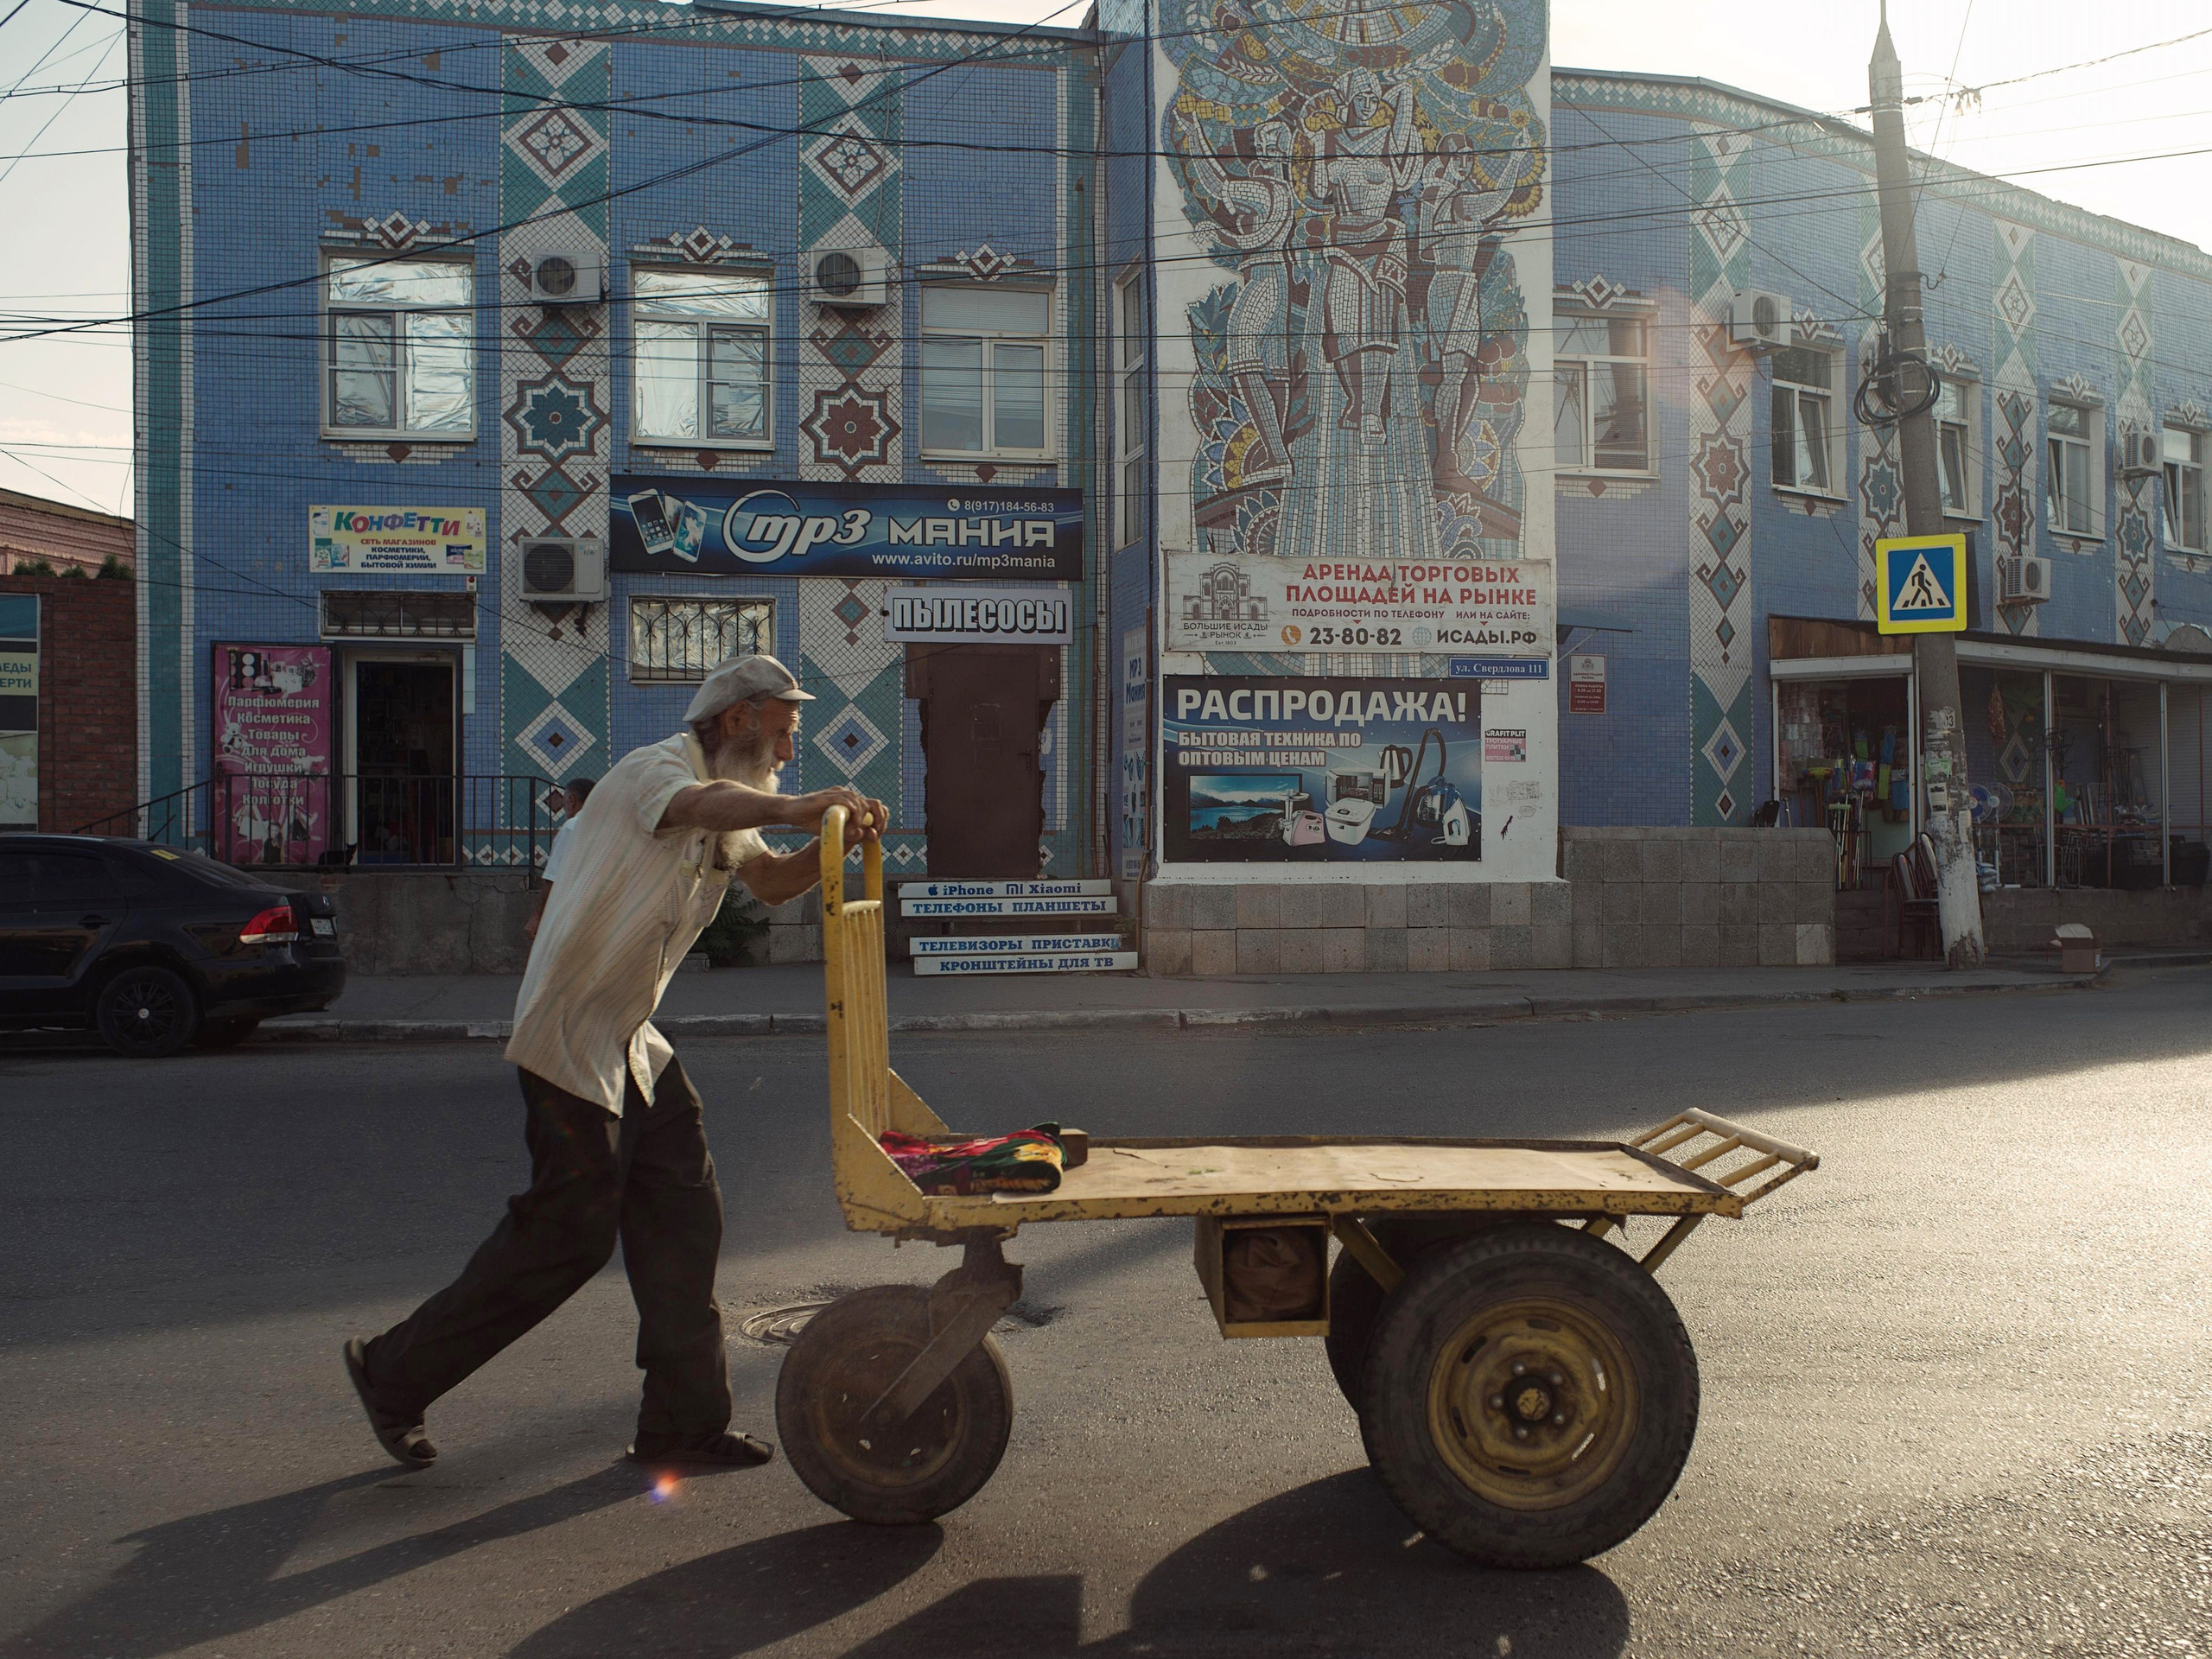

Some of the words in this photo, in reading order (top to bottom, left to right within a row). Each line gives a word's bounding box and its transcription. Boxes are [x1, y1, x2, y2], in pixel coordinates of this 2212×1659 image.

[964, 500, 1055, 512] 8(917)184-56-83
[334, 511, 461, 536] КОНФЕТТИ
[722, 499, 873, 563] mp3
[872, 551, 1056, 569] www.avito.ru/mp3mania
[1302, 563, 1393, 583] АРЕНДА
[1398, 564, 1520, 583] ТОРГОВЫХ
[1286, 582, 1415, 605] ПЛОЩАДЕЙ
[1423, 588, 1453, 604] НА
[1459, 588, 1536, 606] РЫНКЕ
[893, 597, 1066, 634] ПЫЛЕСОСЫ
[1292, 608, 1370, 618] ПОДРОБНОСТИ
[1391, 610, 1445, 619] ТЕЛЕФОНУ
[1456, 611, 1477, 620] ИЛИ
[1480, 611, 1493, 620] НА
[1496, 609, 1530, 620] САЙТЕ:
[1183, 622, 1231, 631] БОЛЬШИЕ
[1310, 627, 1402, 645] 23-80-82
[1437, 629, 1537, 645] ИСАДЫ.РФ
[0, 663, 32, 674] ЕДЫ
[1456, 664, 1470, 674] ул.
[1473, 663, 1525, 675] Свердлова
[1529, 664, 1541, 673] 111
[228, 696, 320, 709] Парфюмерия
[1177, 689, 1466, 728] РАСПРОДАЖА!
[237, 712, 311, 724] Косметика
[248, 728, 300, 741] Товары
[1178, 731, 1262, 747] БЫТОВАЯ
[1264, 731, 1337, 747] ТЕХНИКА
[1338, 732, 1362, 747] ПО
[270, 747, 306, 758] дома
[1178, 751, 1265, 766] ОПТОВЫМ
[1268, 751, 1326, 767] ЦЕНАМ
[245, 762, 302, 774] Игрушки
[943, 885, 994, 896] iPhone
[1029, 883, 1081, 894] Xiaomi
[912, 902, 1003, 914] ТЕЛЕФОНЫ
[1012, 901, 1106, 912] ПЛАНШЕТЫ
[919, 939, 1022, 951] ТЕЛЕВИЗОРЫ
[939, 956, 1053, 971] КРОНШТЕЙНЫ
[1058, 958, 1089, 969] ДЛЯ
[1094, 957, 1114, 968] ТВ
